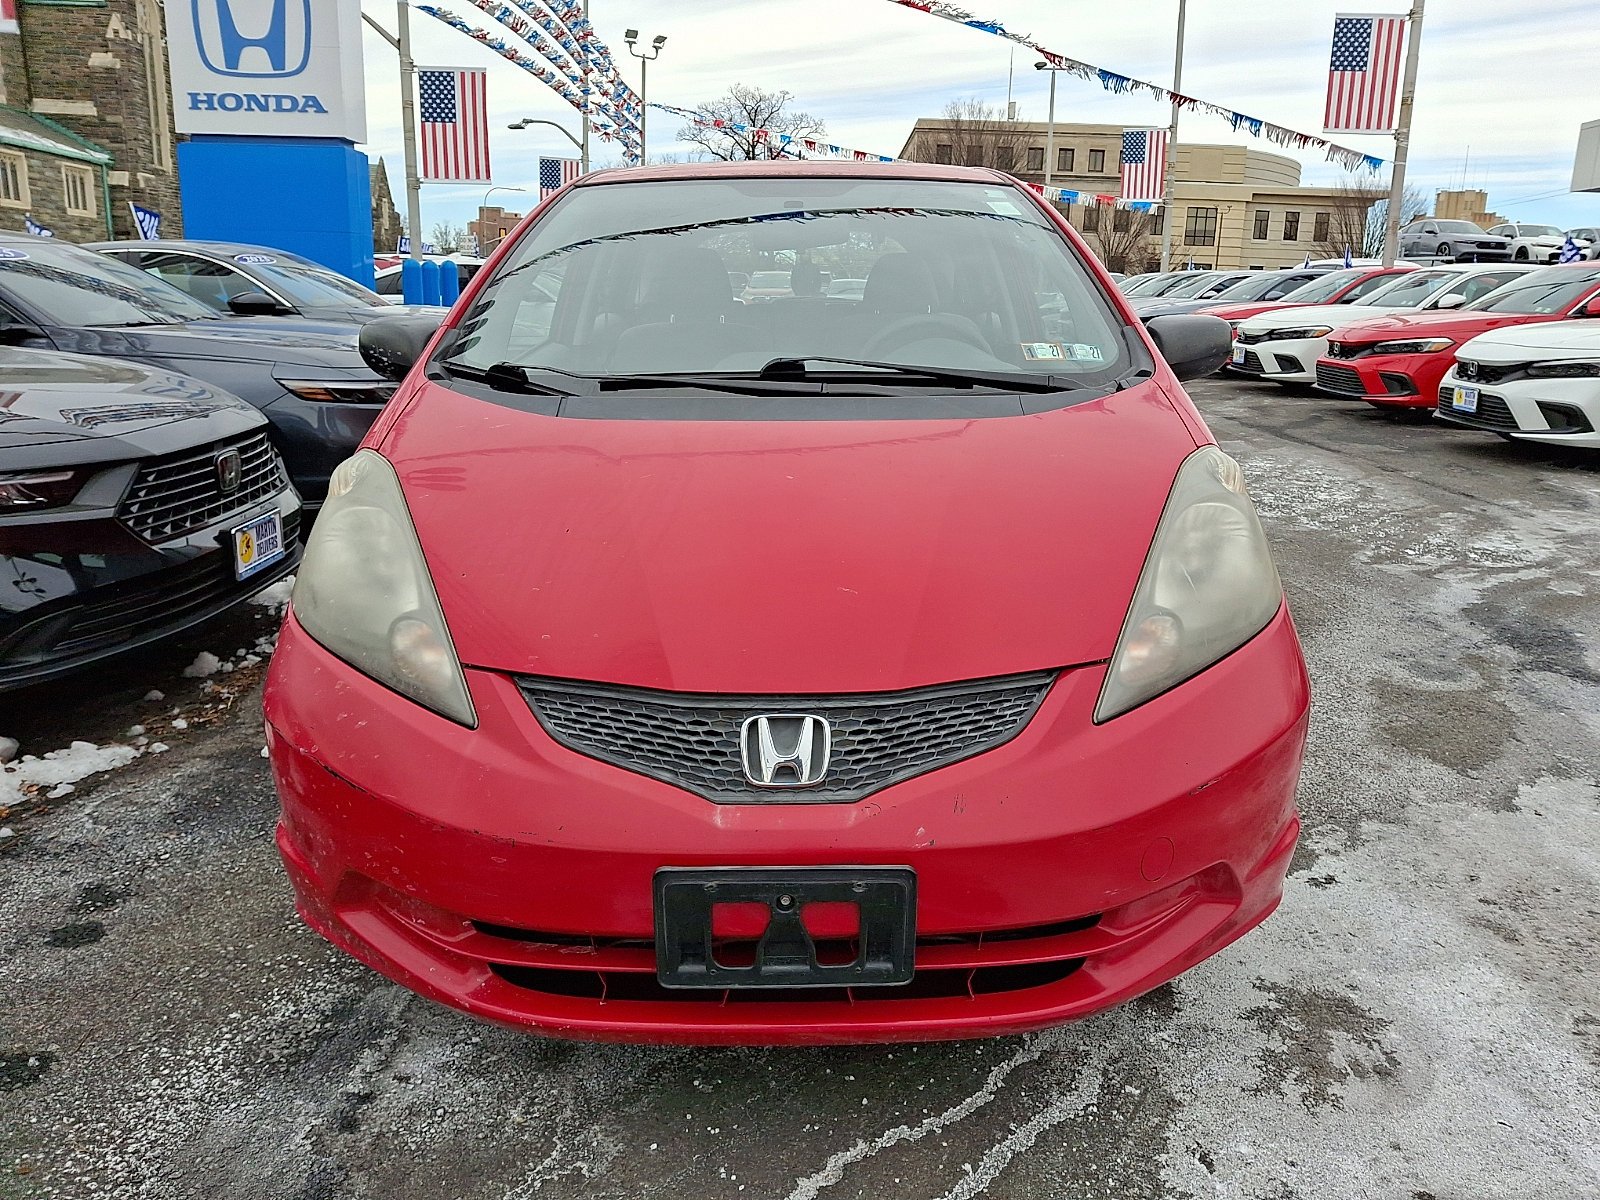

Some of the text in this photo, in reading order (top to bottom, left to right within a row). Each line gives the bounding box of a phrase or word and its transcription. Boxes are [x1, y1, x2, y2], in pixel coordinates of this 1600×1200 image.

[187, 92, 328, 113] HONDA
[255, 519, 277, 542] MARTIN
[256, 535, 278, 557] DELIVERS
